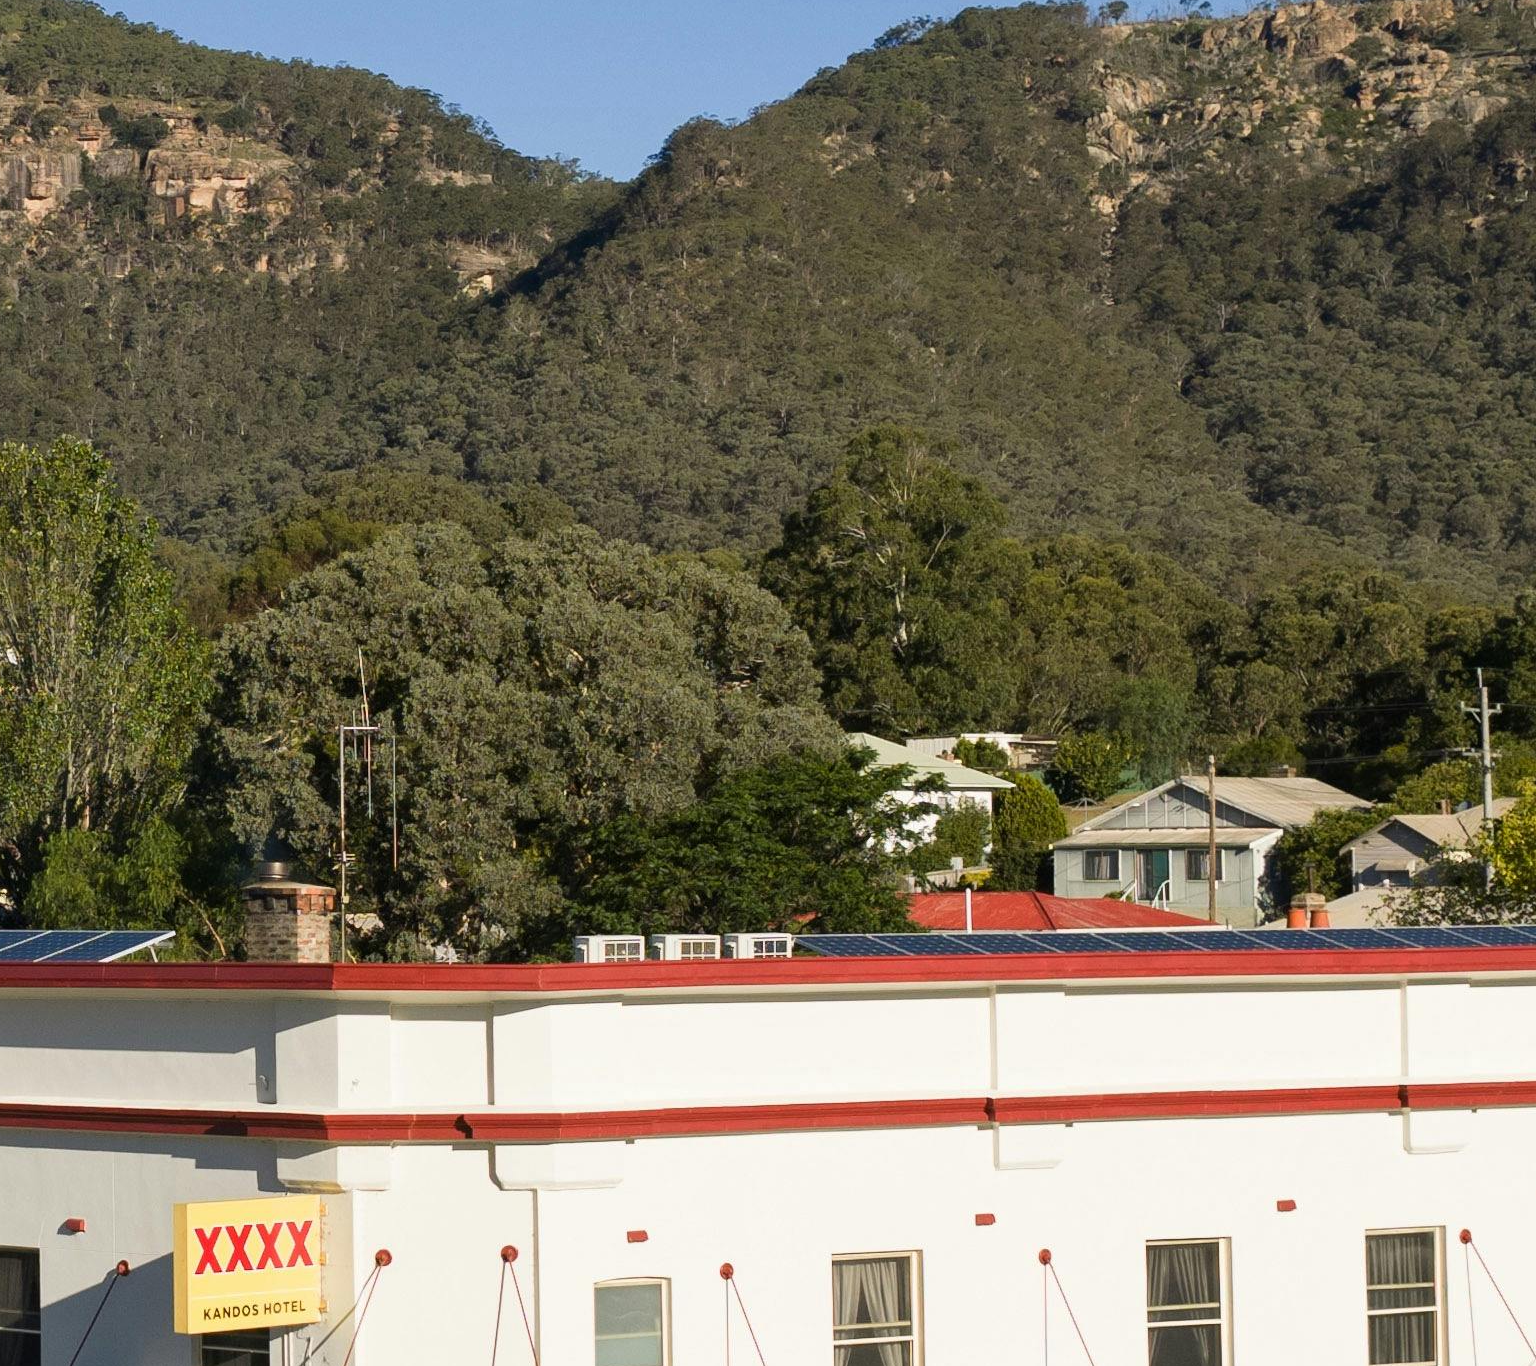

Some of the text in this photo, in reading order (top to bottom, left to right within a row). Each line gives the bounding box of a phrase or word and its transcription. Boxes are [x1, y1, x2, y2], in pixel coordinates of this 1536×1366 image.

[194, 1221, 313, 1275] XXXX
[204, 1301, 306, 1321] KANDOS HOTEL
